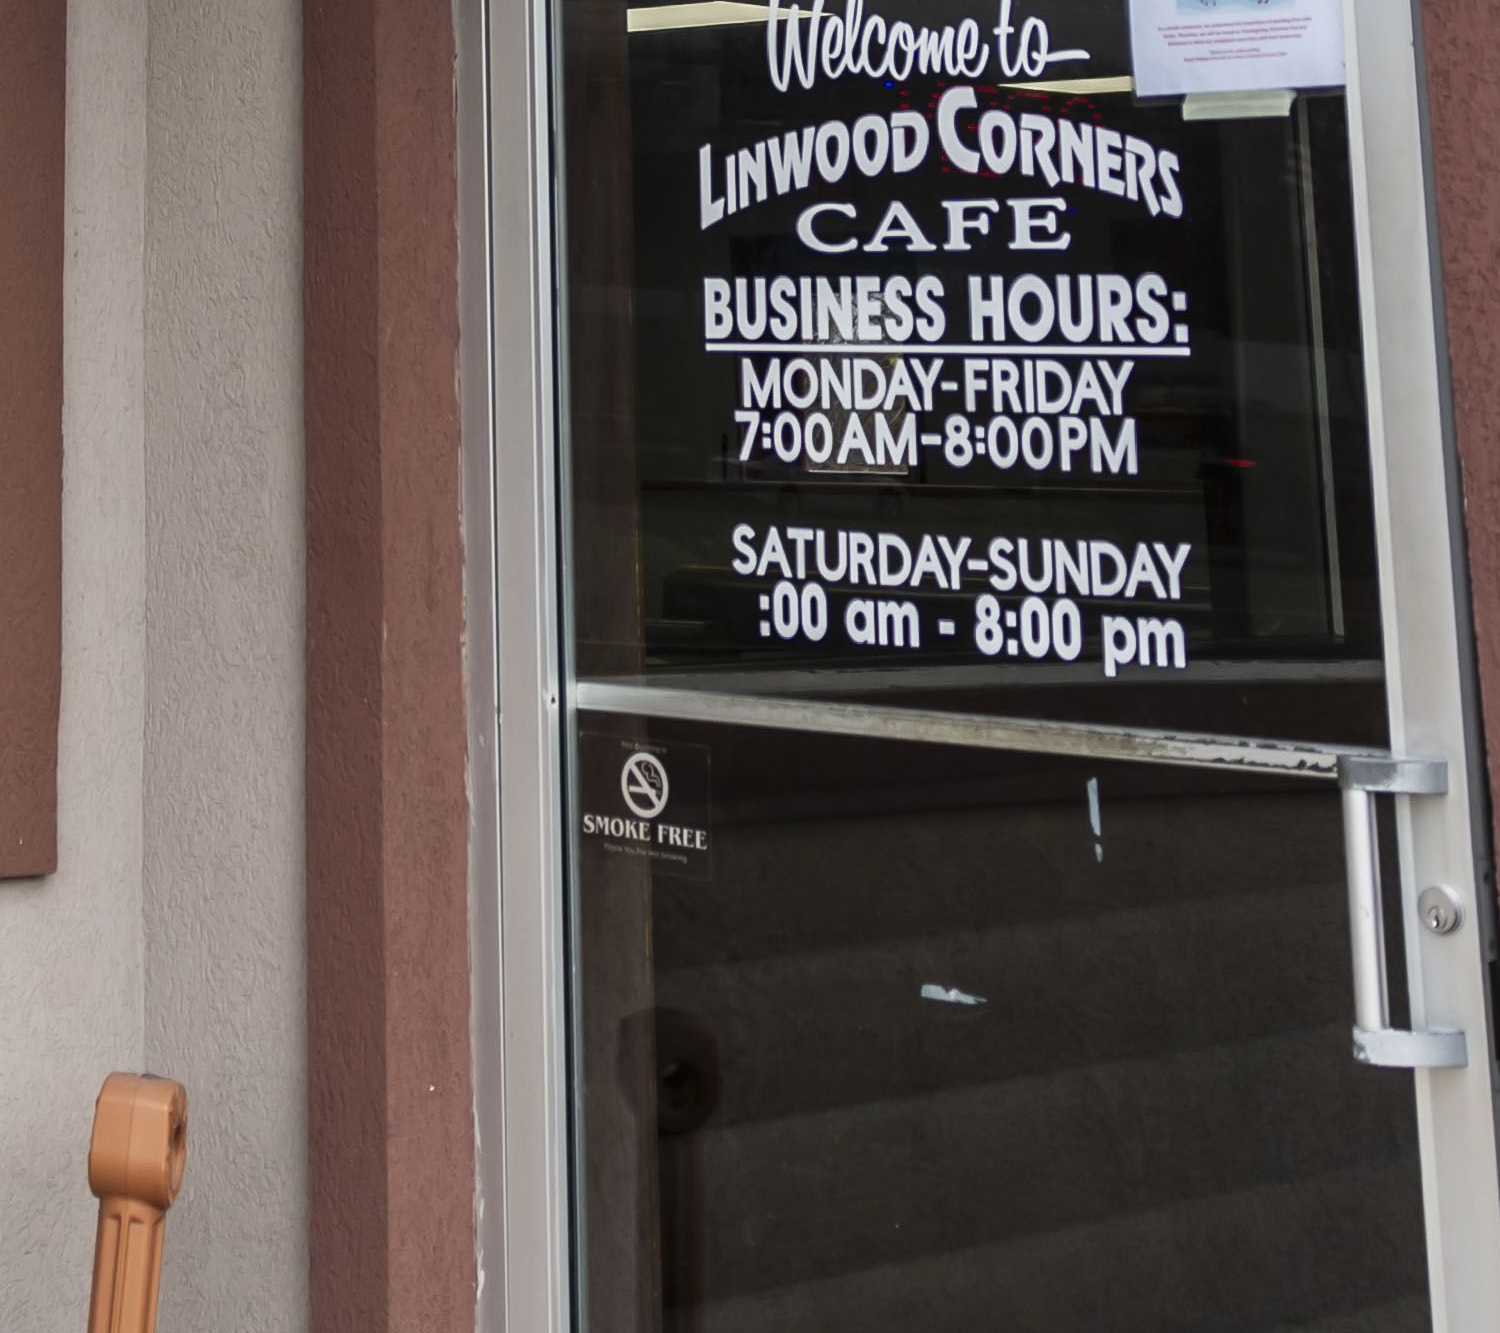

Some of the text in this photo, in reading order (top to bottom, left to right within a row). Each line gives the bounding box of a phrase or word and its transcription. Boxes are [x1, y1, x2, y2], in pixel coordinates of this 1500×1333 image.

[698, 109, 930, 231] LINWOOD
[936, 85, 1184, 219] CORNERS
[796, 196, 1071, 253] CAFE
[703, 273, 1190, 344] BUSINESS HOURS:
[740, 356, 1135, 416] MONDAY-FRIDAY
[731, 522, 1191, 600] SATURDAY-SUNDAY
[845, 596, 921, 649] am
[973, 593, 1083, 662] 8:00
[1102, 612, 1186, 678] pm
[582, 812, 708, 851] SMOKE FREE
